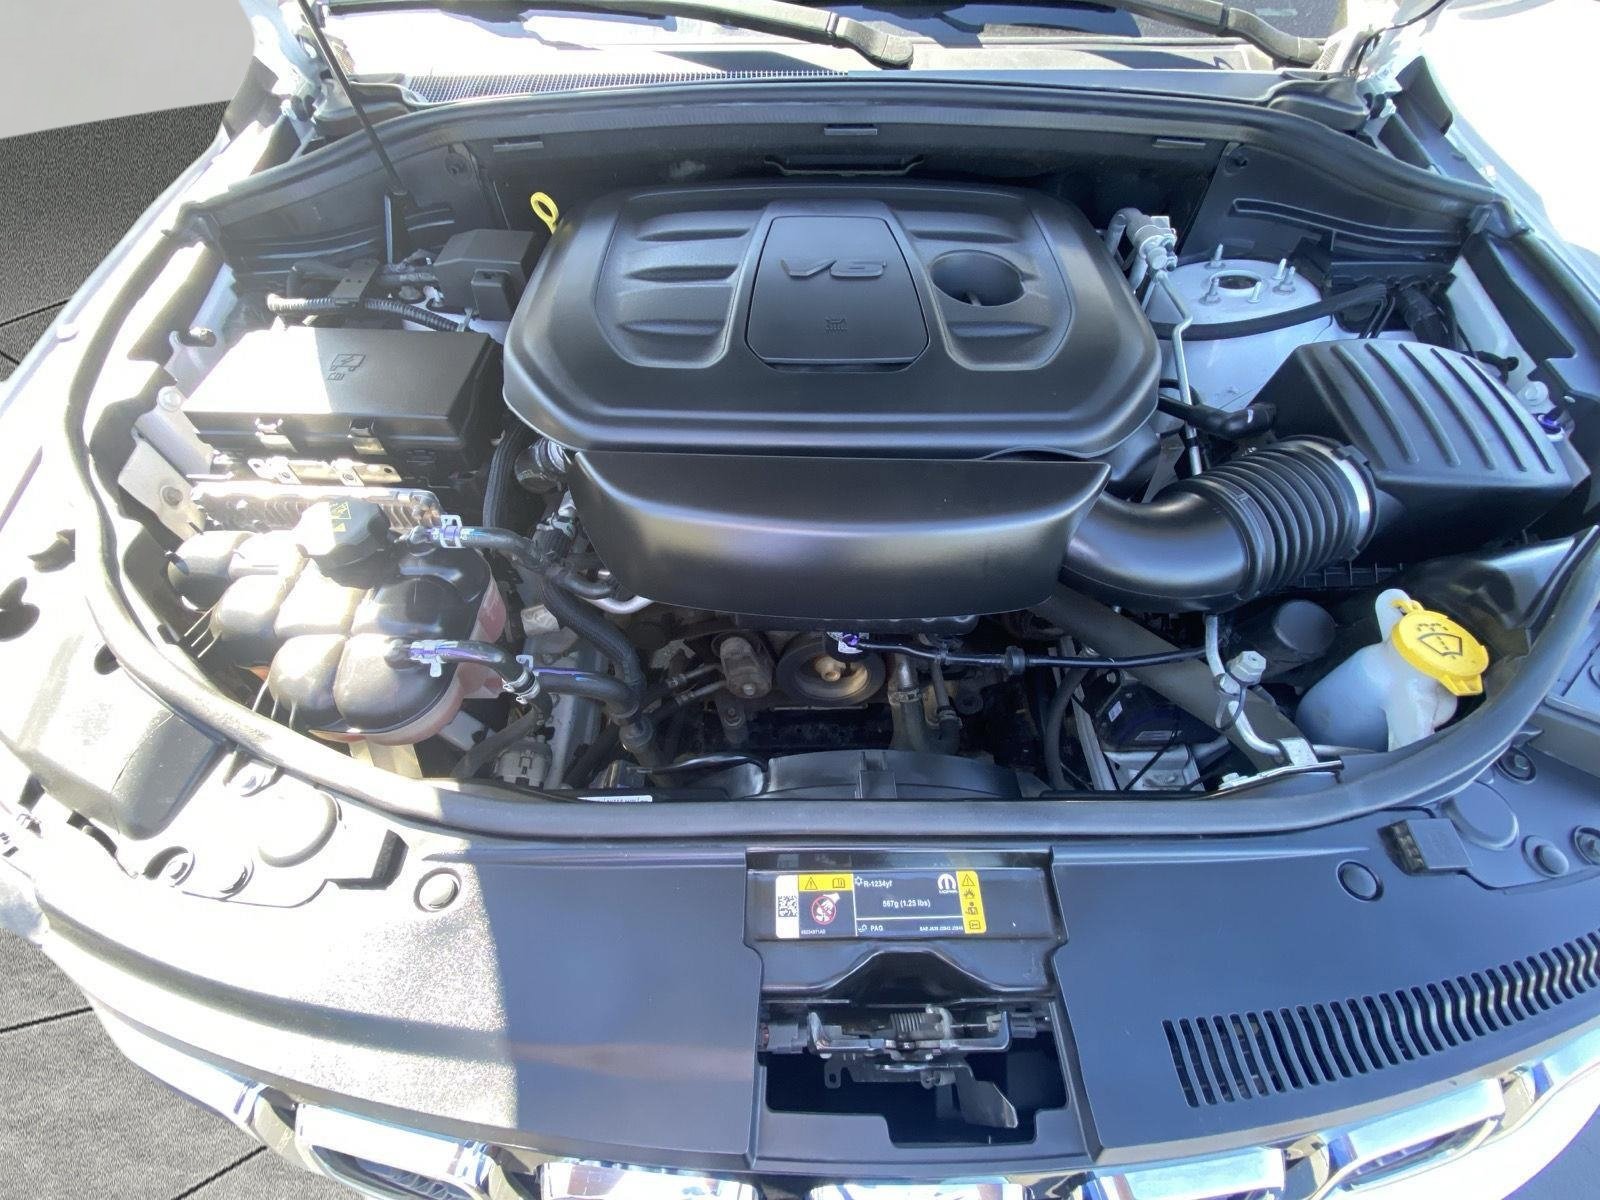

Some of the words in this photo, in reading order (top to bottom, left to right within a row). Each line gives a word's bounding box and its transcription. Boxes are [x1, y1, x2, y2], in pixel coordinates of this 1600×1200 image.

[863, 880, 893, 889] R-1234yf
[900, 899, 917, 909] (1.25
[917, 898, 931, 908] lbs)
